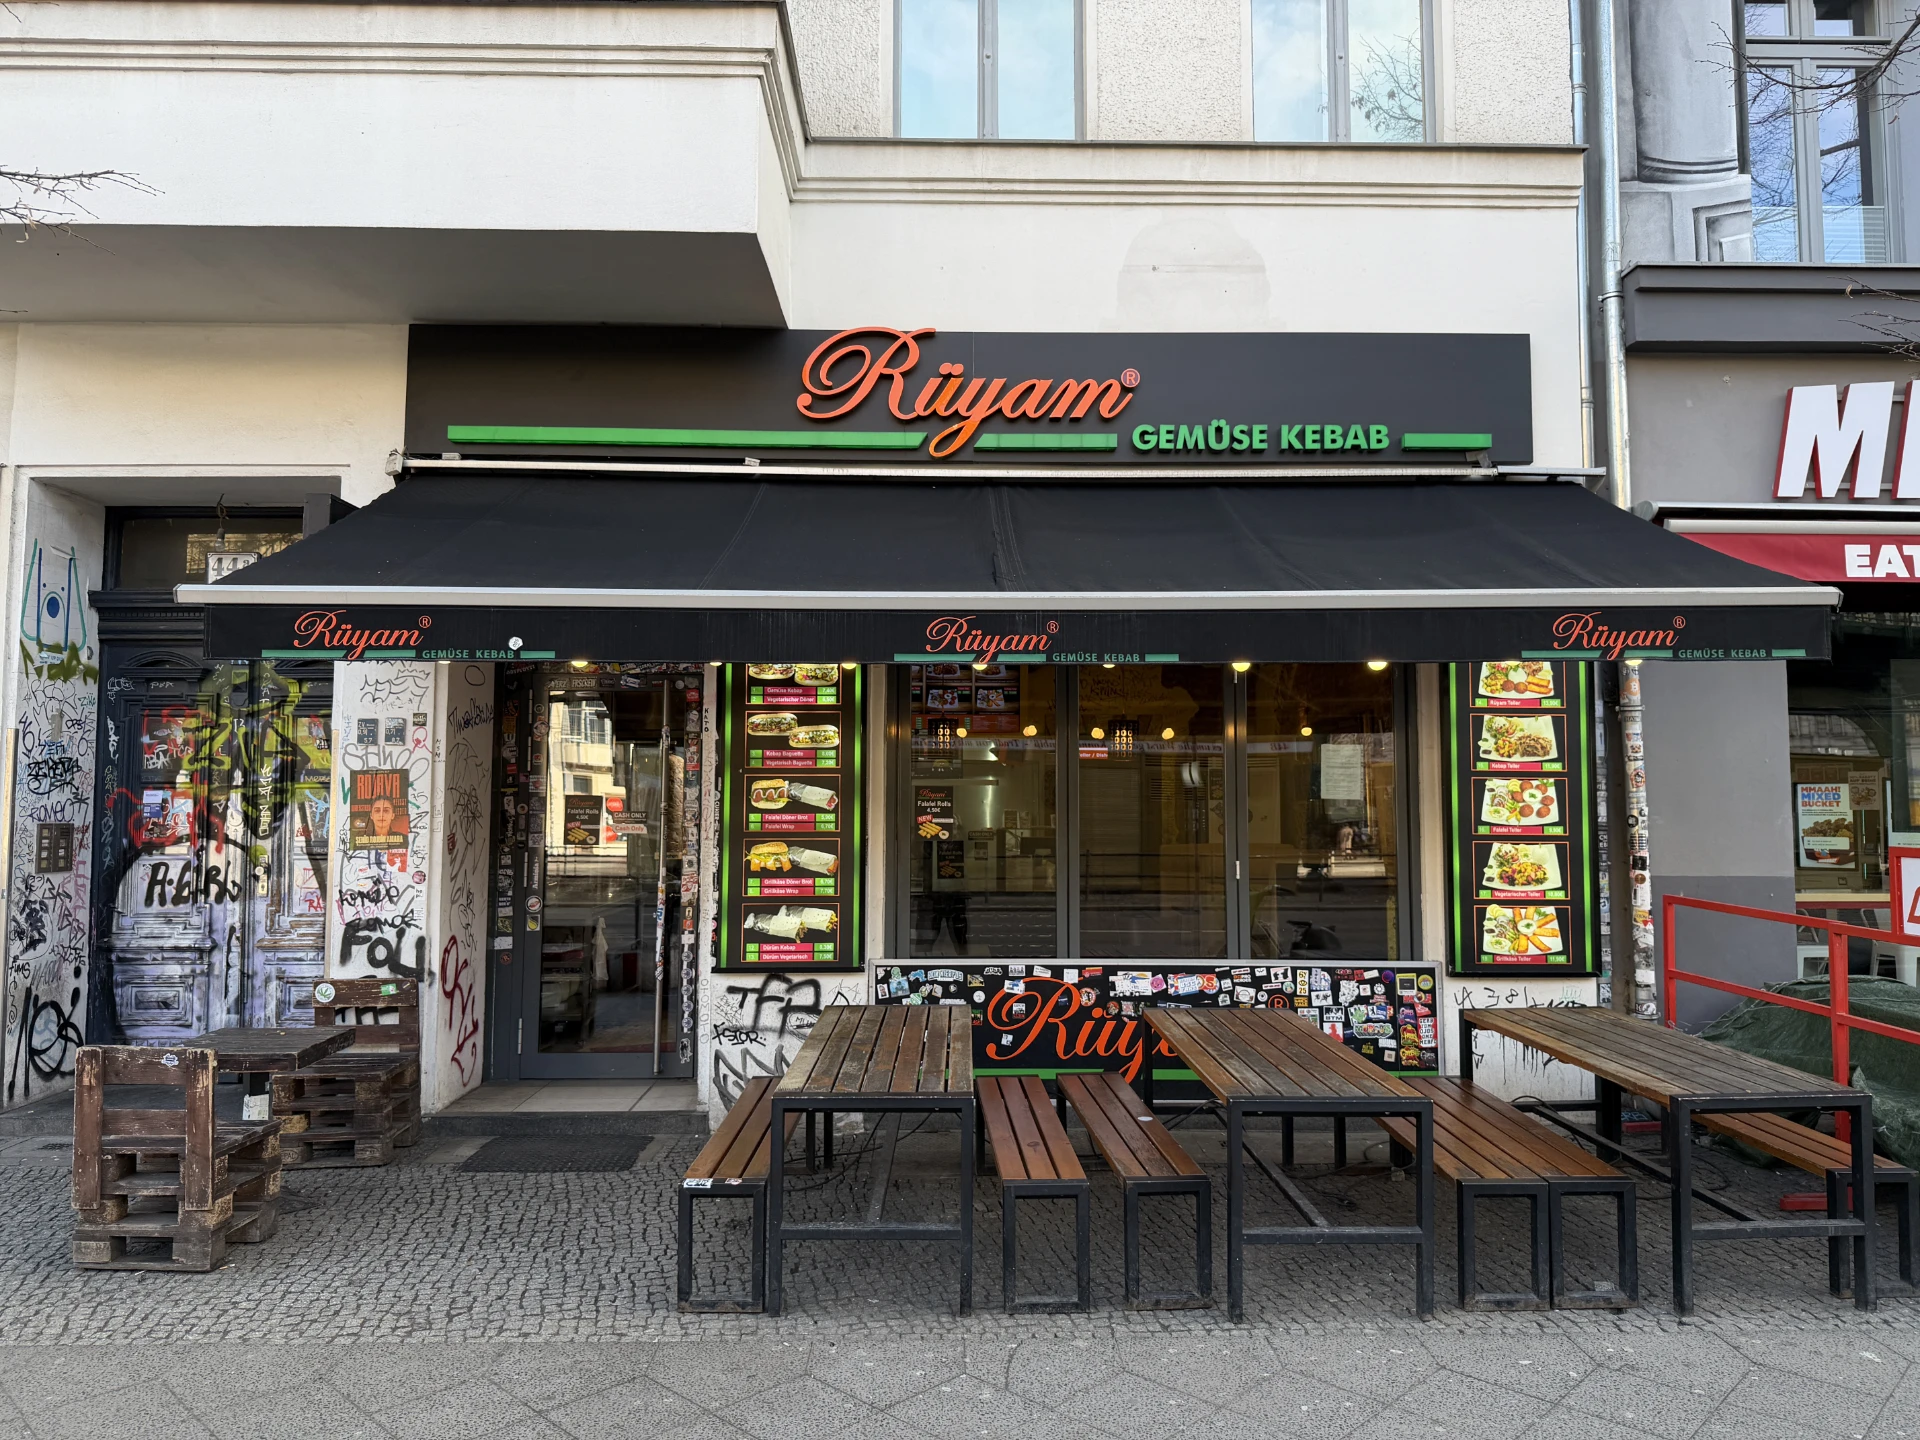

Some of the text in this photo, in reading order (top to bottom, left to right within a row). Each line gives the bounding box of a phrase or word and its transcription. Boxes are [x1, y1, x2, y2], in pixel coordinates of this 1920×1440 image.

[1131, 418, 1390, 452] GEMÜSE KEBAB
[422, 647, 515, 659] GEMÜSE KEBAB
[1052, 652, 1140, 662] GEMÜSE KEBAB
[1678, 648, 1767, 658] GEMÜSE KEBAB
[357, 773, 400, 799] ROJAVA
[1801, 792, 1841, 801] MIXED
[1801, 800, 1841, 808] BUCKET
